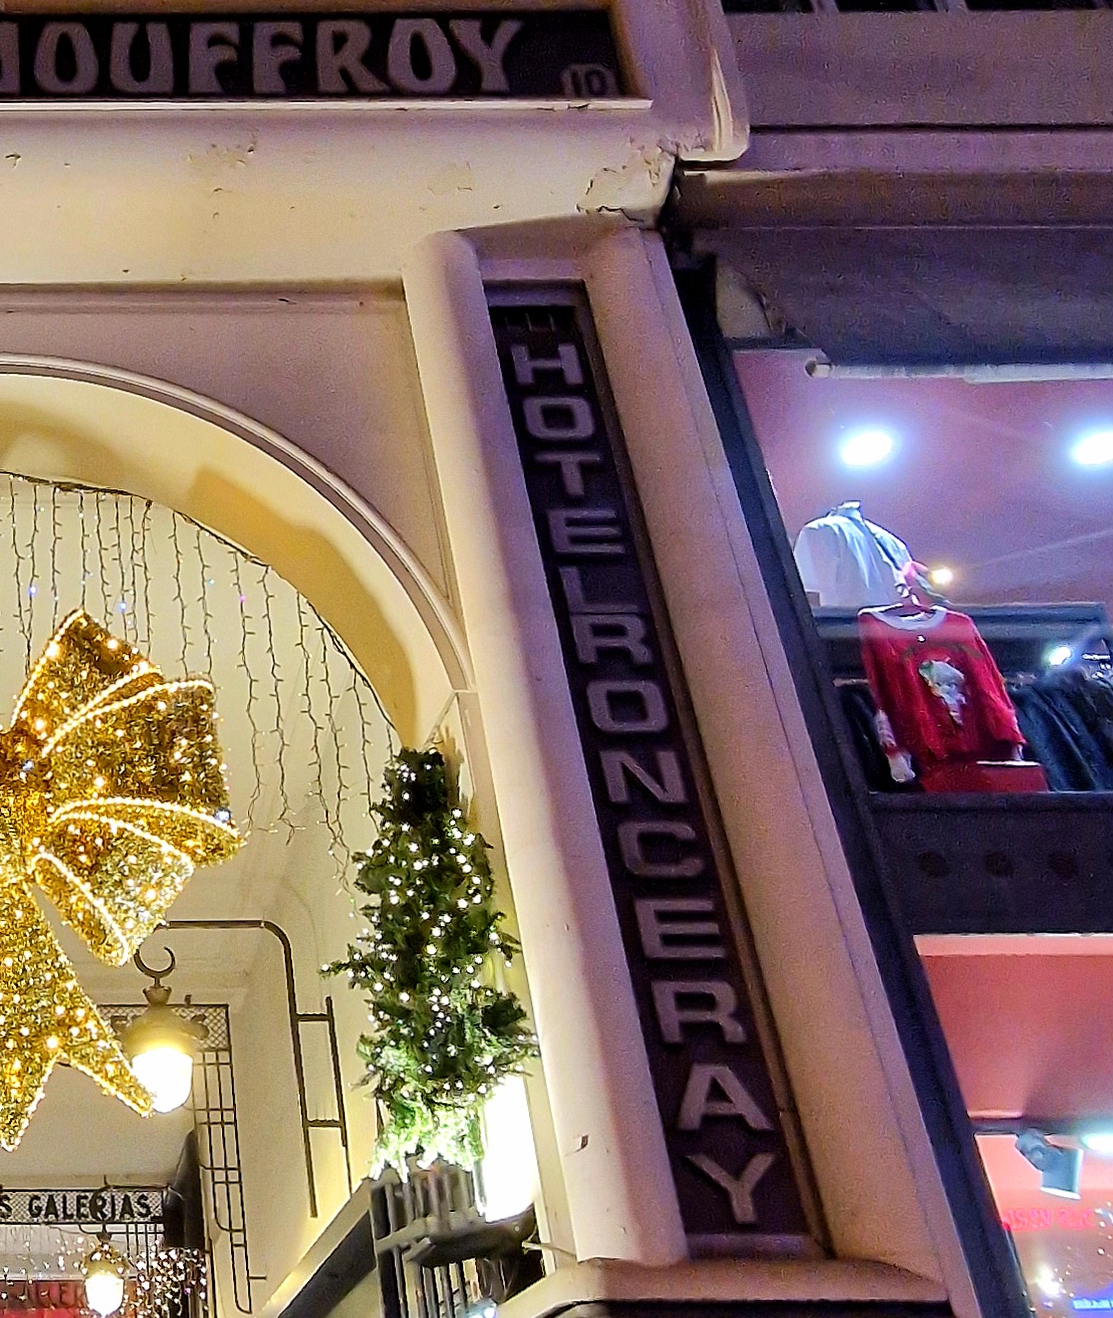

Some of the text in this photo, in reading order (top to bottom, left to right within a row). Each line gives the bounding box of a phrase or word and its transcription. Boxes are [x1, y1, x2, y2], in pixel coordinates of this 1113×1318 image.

[509, 342, 775, 1225] HOTEL RONCERAY
[29, 1193, 153, 1219] GALERIAS
